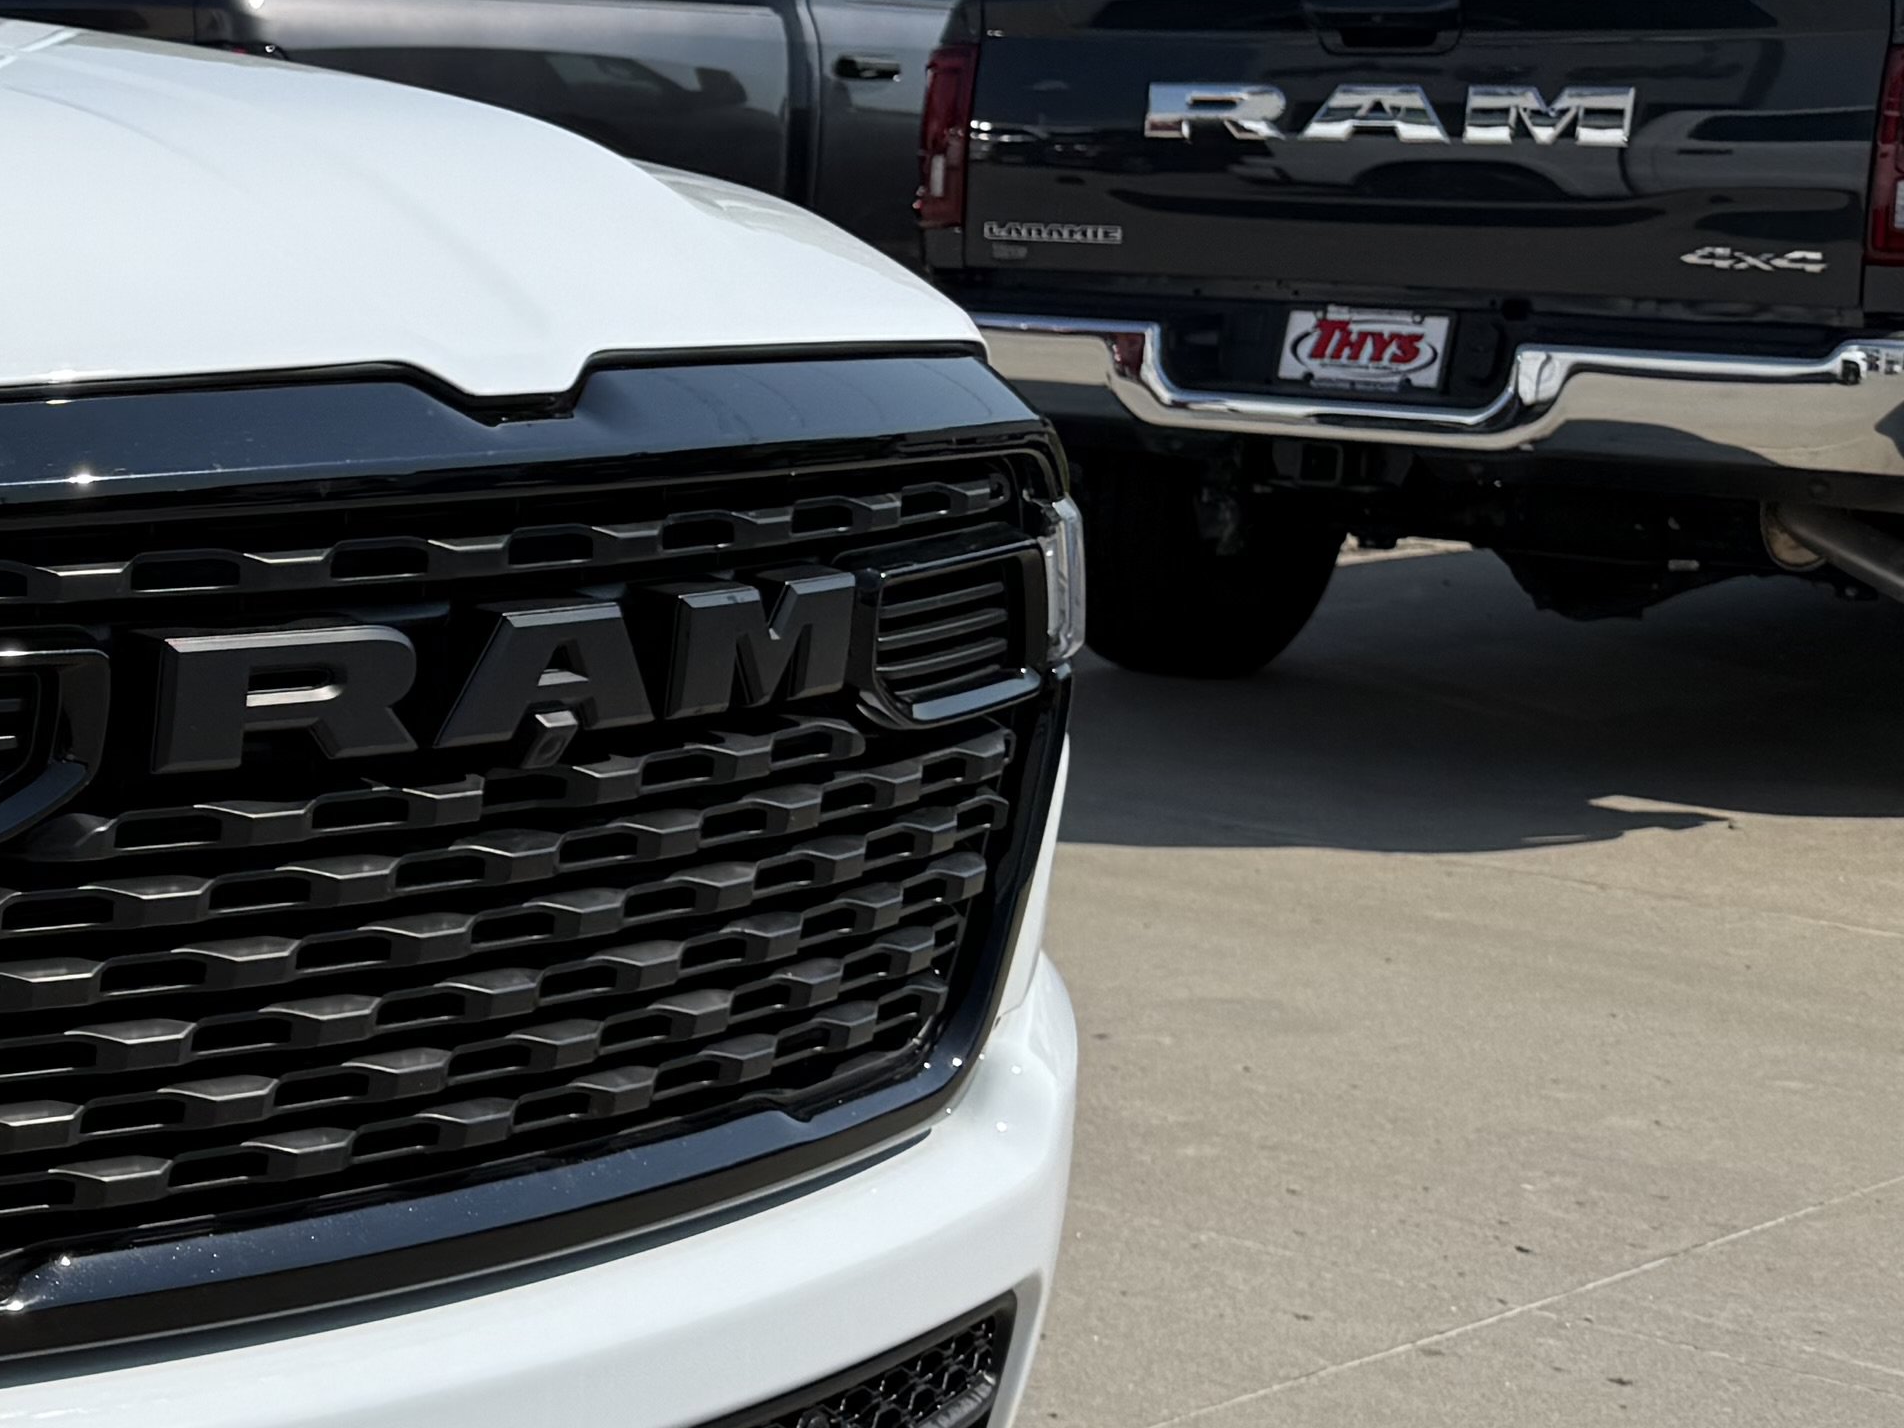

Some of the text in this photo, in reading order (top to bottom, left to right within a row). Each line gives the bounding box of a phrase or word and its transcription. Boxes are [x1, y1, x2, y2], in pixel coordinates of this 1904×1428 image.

[1144, 81, 1637, 149] RAM
[983, 221, 1123, 244] LARAMIE
[152, 573, 857, 772] RAM
